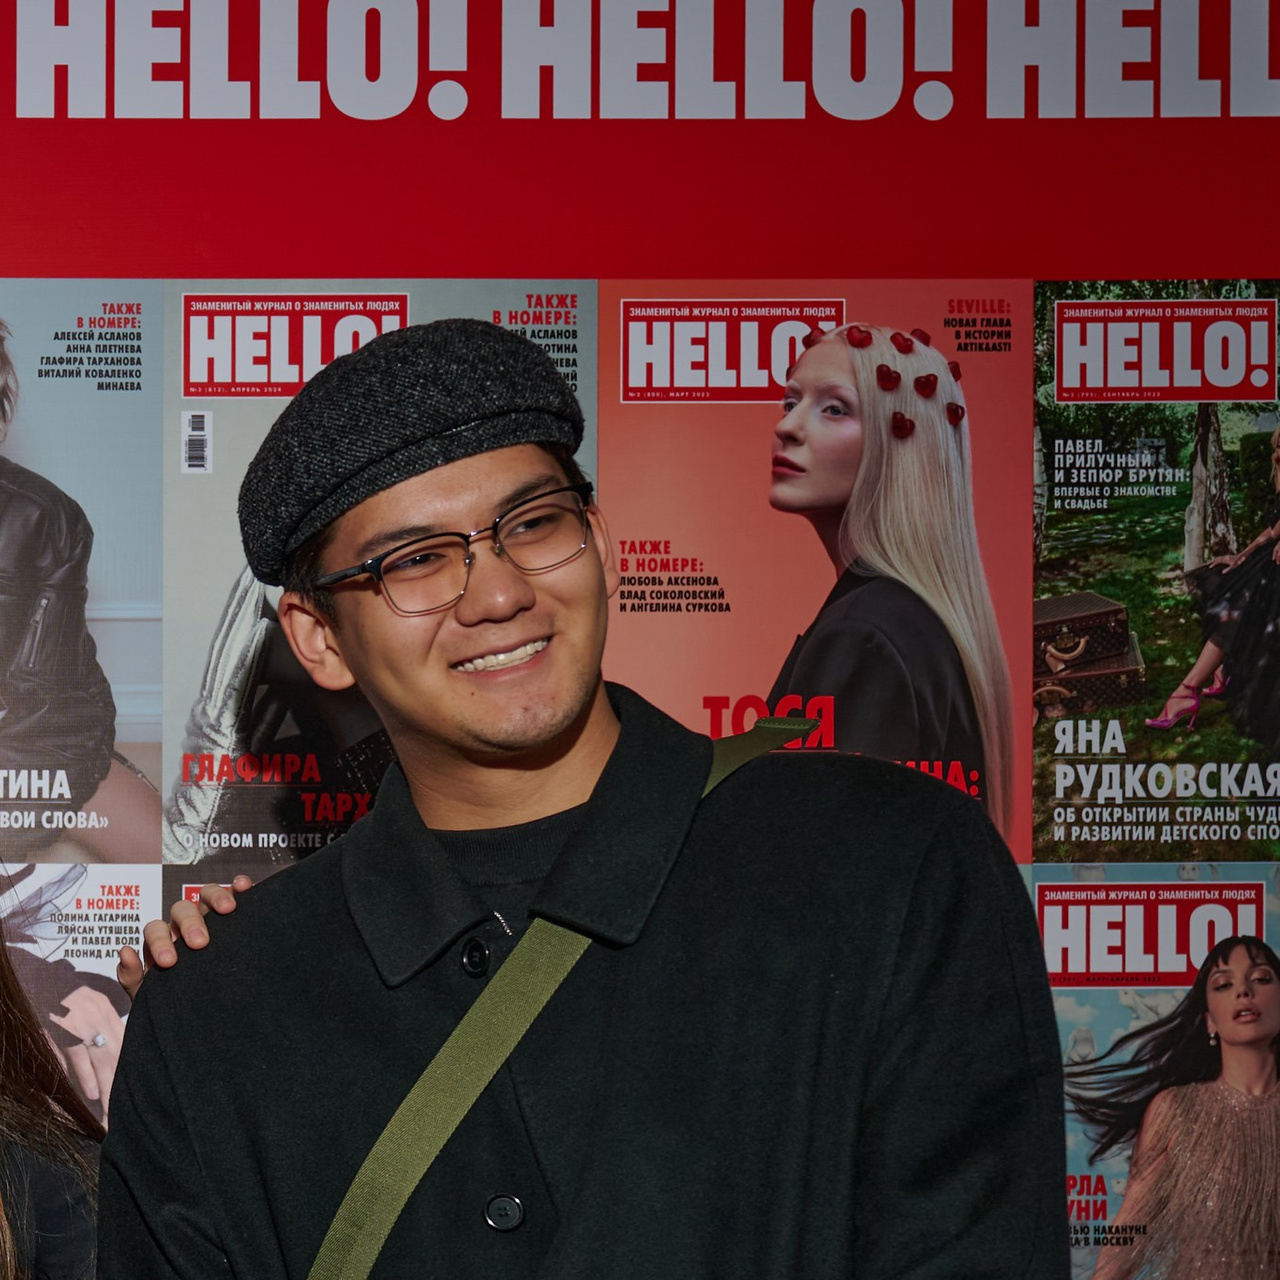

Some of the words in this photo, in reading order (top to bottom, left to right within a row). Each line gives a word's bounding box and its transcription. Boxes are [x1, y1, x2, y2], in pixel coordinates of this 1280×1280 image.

[16, 0, 468, 121] HELLO!
[501, 0, 954, 121] HELLO!
[526, 294, 578, 309] ТАКЖЕ
[947, 299, 1011, 314] SEVILLE:
[492, 310, 501, 325] В
[508, 310, 577, 325] НОМЕРЕ:
[629, 305, 690, 317] ЗНАМЕНИТЫЙ
[691, 307, 730, 317] ЖУРНАЛ
[740, 307, 801, 317] ЗНАМЕНИТЫХ
[802, 307, 836, 318] ЛЮДЯХ
[943, 318, 978, 328] НОВАЯ
[980, 318, 1012, 328] ГЛАВА
[530, 329, 578, 340] АСЛАНОВ
[66, 344, 93, 354] АННА
[95, 344, 142, 354] ПЛЕТНЕВА
[956, 342, 1012, 352] ARTIK&ASTI
[1062, 321, 1269, 388] HELLO!
[1054, 439, 1102, 453] ПАВЕЛ
[1054, 453, 1152, 468] ПРИЛУЧНЫЙ
[1054, 469, 1064, 483] И
[1070, 469, 1123, 483] ЗЕПЮР
[1129, 469, 1190, 483] БРУТЯН:
[620, 577, 664, 586] ЛЮБОВЬ
[666, 577, 719, 586] АКСЕНОВА
[620, 590, 647, 601] ВЛАД
[649, 588, 725, 600] СОКОЛОВСКИЙ
[1053, 719, 1127, 754] ЯНА
[182, 753, 320, 783] ГЛАФИРА
[1055, 763, 1280, 804] РУДКОВСКАЯ
[41, 811, 109, 829] СЛОВА»
[1053, 807, 1076, 823] ОБ
[1082, 807, 1170, 823] ОТКРЫТИИ
[1175, 807, 1240, 822] СТРАНЫ
[1053, 825, 1065, 841] И
[1071, 825, 1156, 841] РАЗВИТИИ
[1160, 824, 1241, 843] ДЕТСКОГО
[100, 885, 140, 896] ТАКЖЕ
[50, 913, 90, 923] ПОЛИНА
[93, 913, 140, 923] ГАГАРИНА
[57, 924, 95, 935] ЛЯЙСАН
[98, 925, 140, 935] УТЯШЕВА
[1093, 1225, 1148, 1235] НАКАНУНЕ
